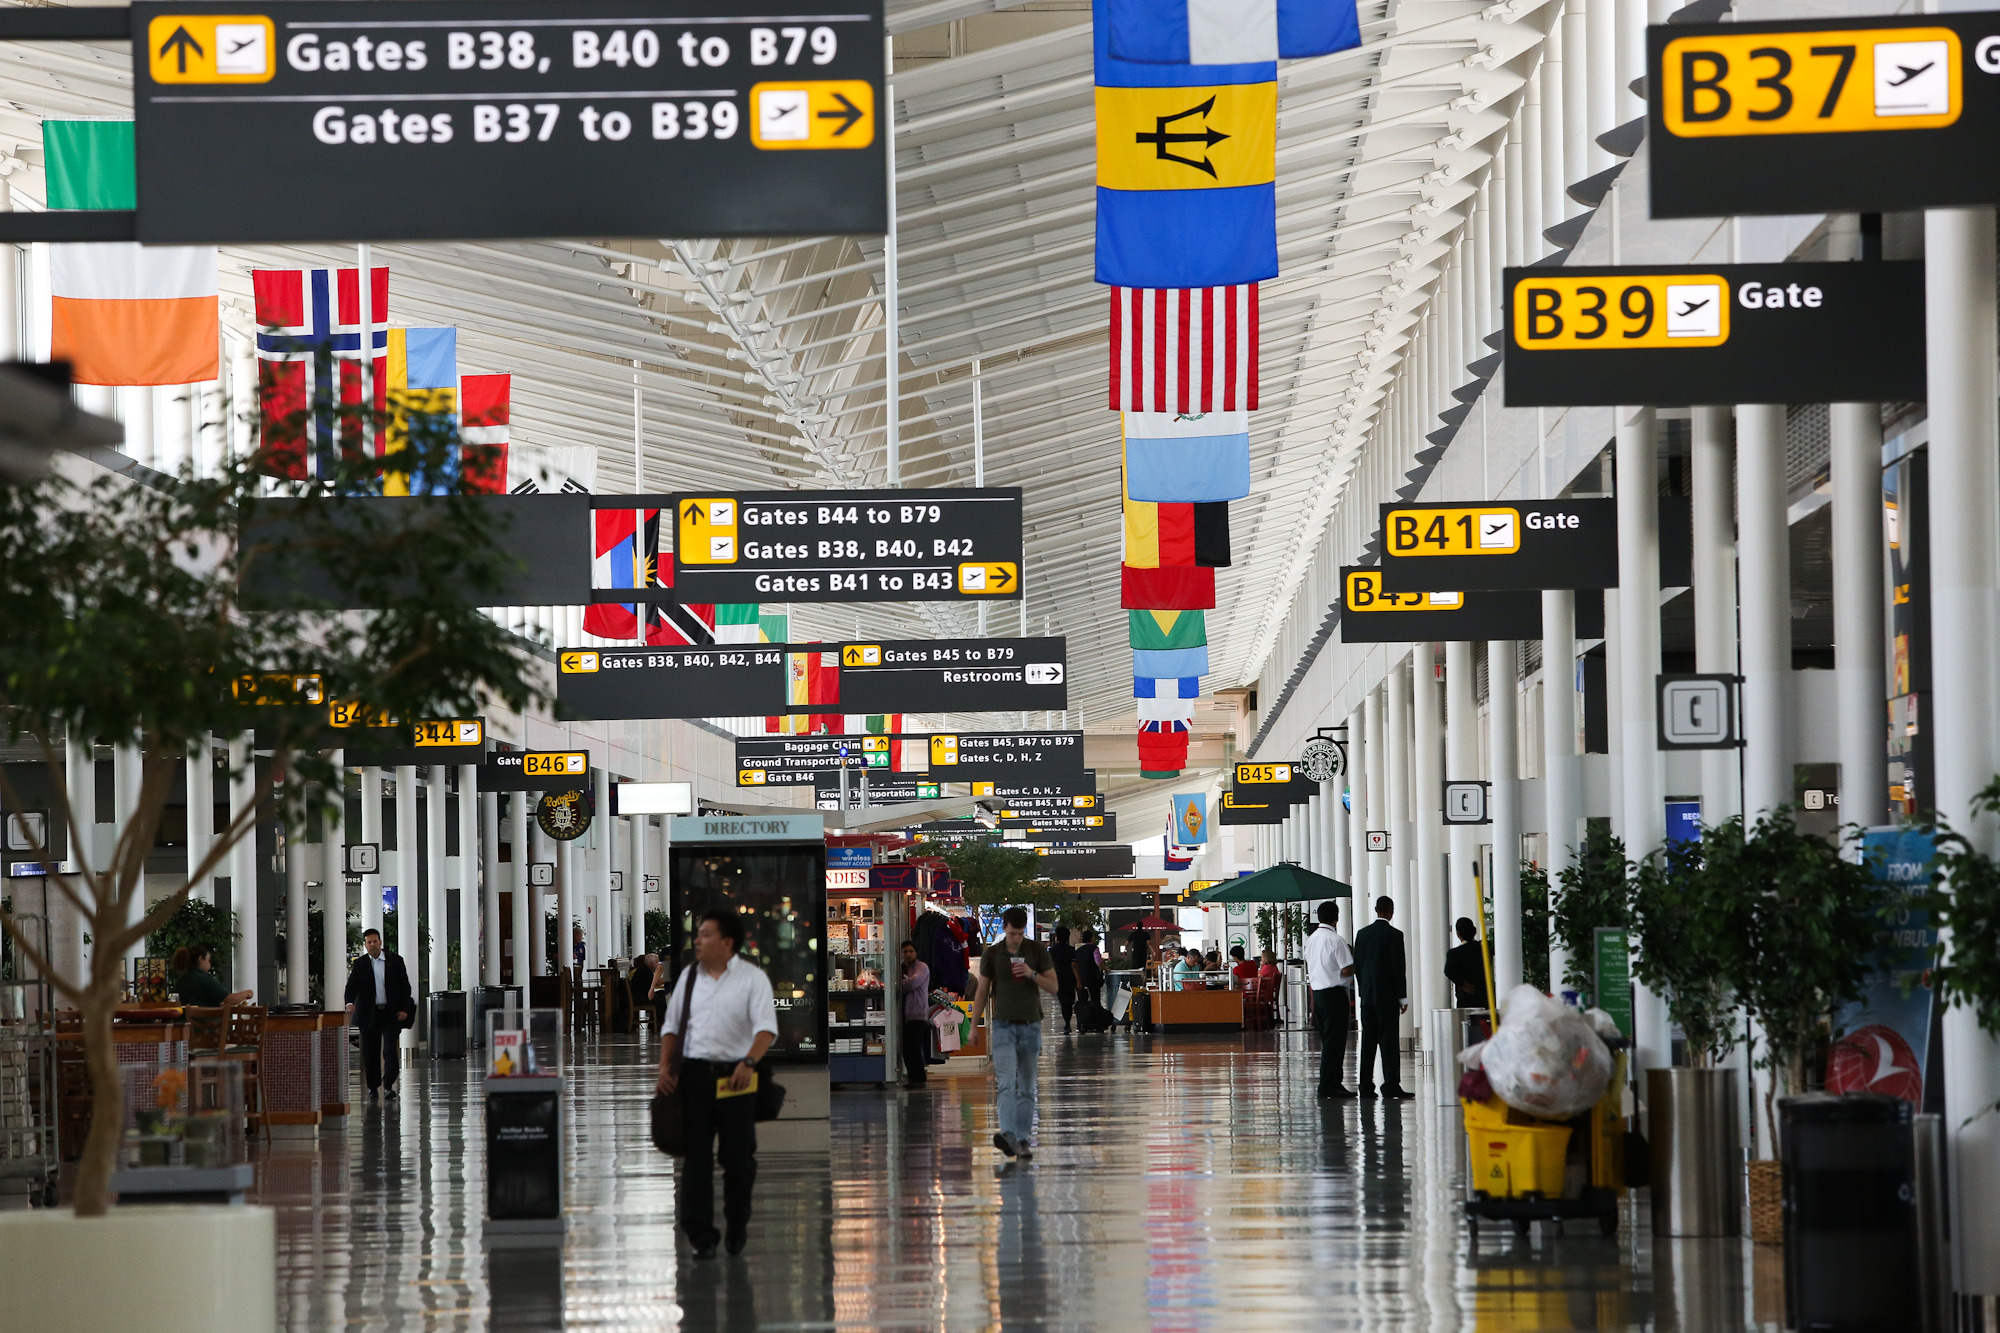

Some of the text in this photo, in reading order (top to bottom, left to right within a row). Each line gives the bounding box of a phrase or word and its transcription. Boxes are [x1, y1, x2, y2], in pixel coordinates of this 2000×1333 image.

[286, 26, 838, 74] Gates B38, B40 to B79
[1681, 45, 1857, 123] B37
[312, 101, 739, 145] Gates B37 to B39
[1527, 281, 1824, 340] B39 Gate
[743, 506, 941, 526] Gates B44 to B79
[1395, 511, 1580, 550] B41 Gate
[743, 539, 974, 561] Gates B38, B40, B42
[755, 572, 953, 593] Gates B41 to B43
[602, 653, 781, 669] Gates B38, B40, B42, B44
[885, 648, 1014, 662] Gates B45 to B79
[943, 670, 1023, 683] Restrooms
[784, 742, 829, 752] Baggage
[960, 736, 1074, 748] Gates B45, B47 to B79
[960, 752, 1042, 763] Gates C, D, H, Z
[1302, 744, 1338, 763] STARBUCKS
[497, 756, 565, 773] Gate B46
[743, 758, 781, 768] Ground
[768, 772, 815, 782] Gate B46
[1241, 767, 1273, 781] B45
[1306, 769, 1335, 781] COFFEE
[543, 789, 581, 807] Potbelly
[995, 787, 1019, 796] Gates
[1021, 787, 1031, 795] C,
[1032, 787, 1042, 795] D,
[1044, 787, 1054, 795] H,
[1035, 799, 1054, 807] B45,
[1056, 799, 1072, 807] B47
[704, 821, 790, 835] DIRECTORY
[1032, 819, 1053, 827] Gates
[1887, 863, 1922, 880] FROM
